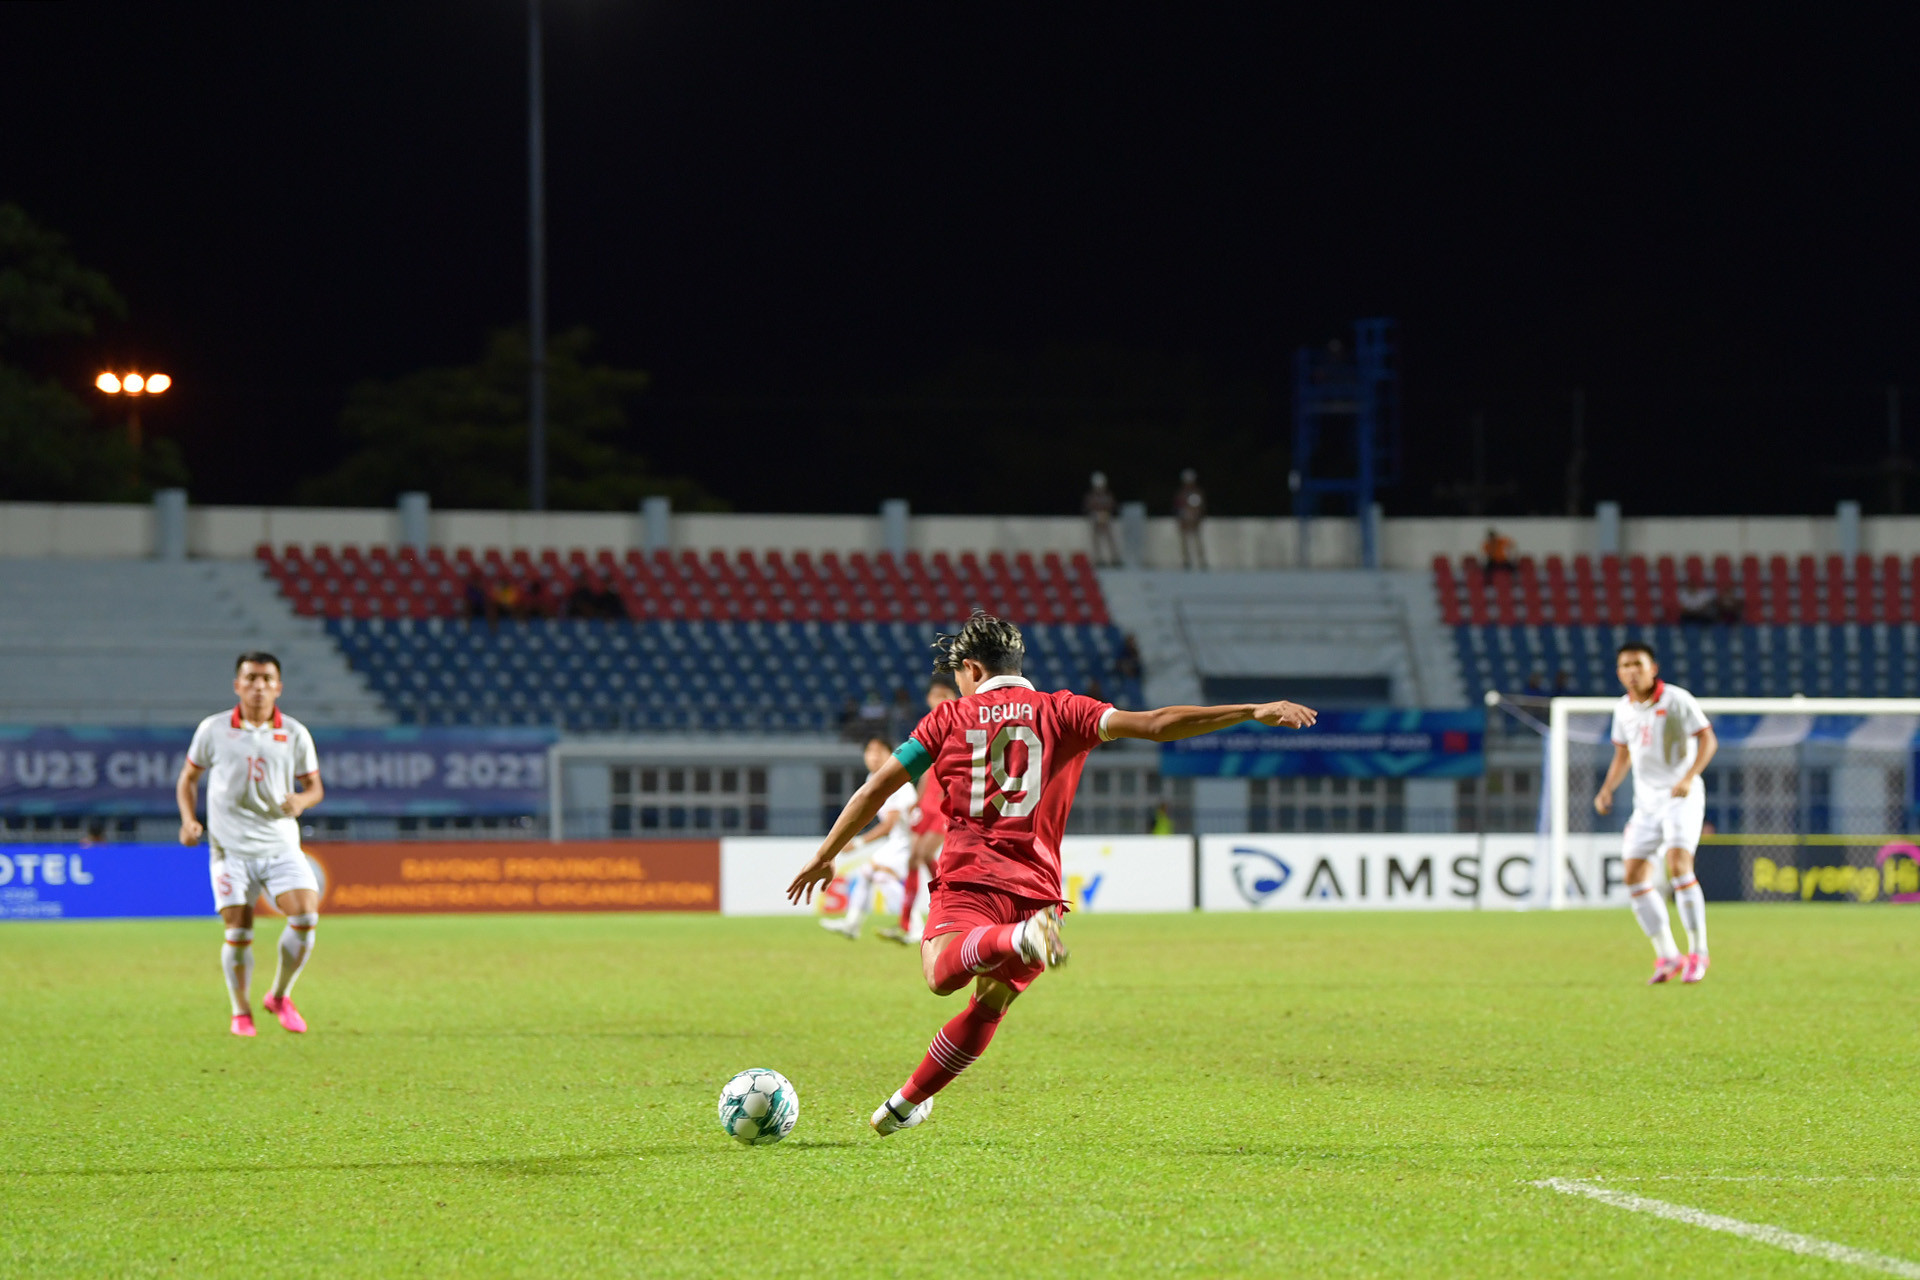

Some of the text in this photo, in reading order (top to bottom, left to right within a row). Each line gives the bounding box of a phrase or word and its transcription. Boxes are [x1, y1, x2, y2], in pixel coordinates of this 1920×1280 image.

[979, 702, 1033, 724] DEWA
[15, 752, 98, 788] U23
[247, 756, 266, 782] 15
[965, 726, 1043, 818] 19
[1752, 857, 1880, 902] Rayong
